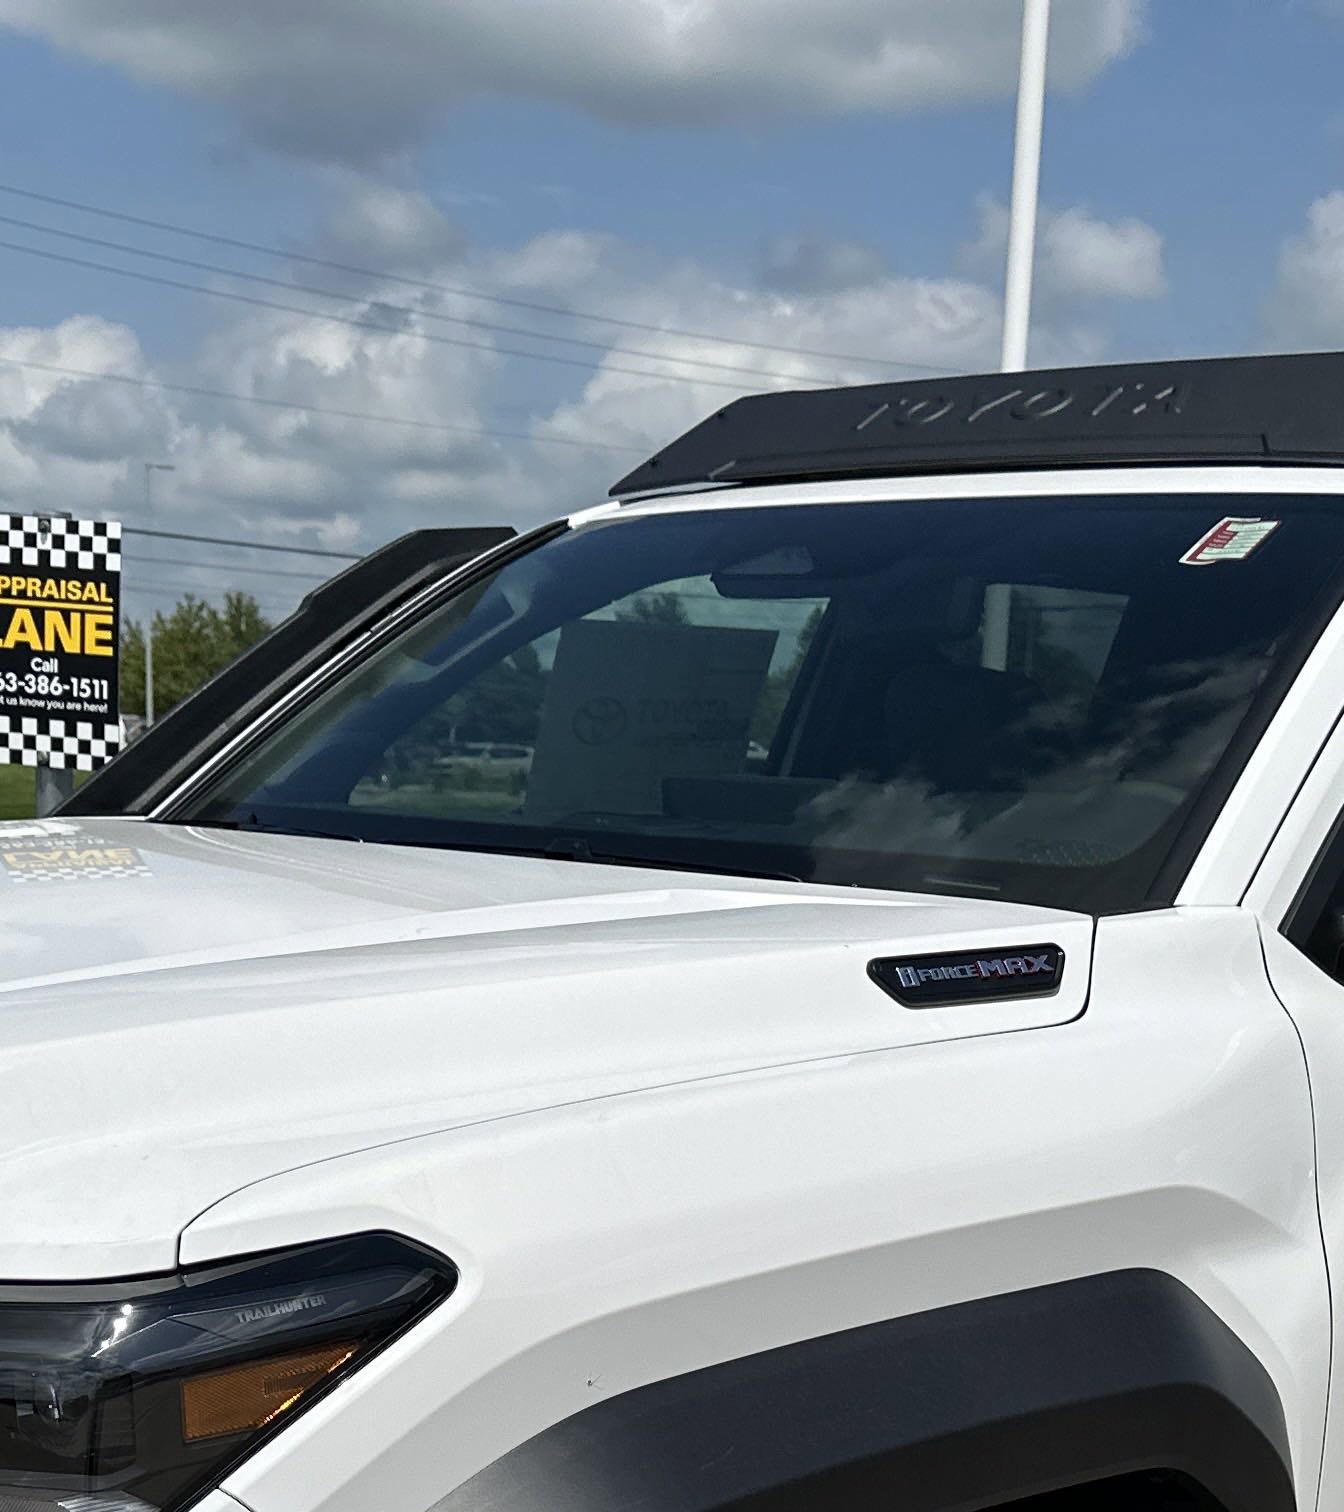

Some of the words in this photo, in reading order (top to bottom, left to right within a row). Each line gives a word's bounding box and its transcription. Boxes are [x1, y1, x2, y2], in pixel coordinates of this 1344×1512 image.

[30, 656, 59, 674] Call
[6, 696, 18, 706] us
[19, 696, 45, 708] know
[46, 700, 65, 711] you
[66, 701, 82, 712] are
[83, 702, 109, 714] here!
[236, 1294, 328, 1323] TRAILHUNTER
